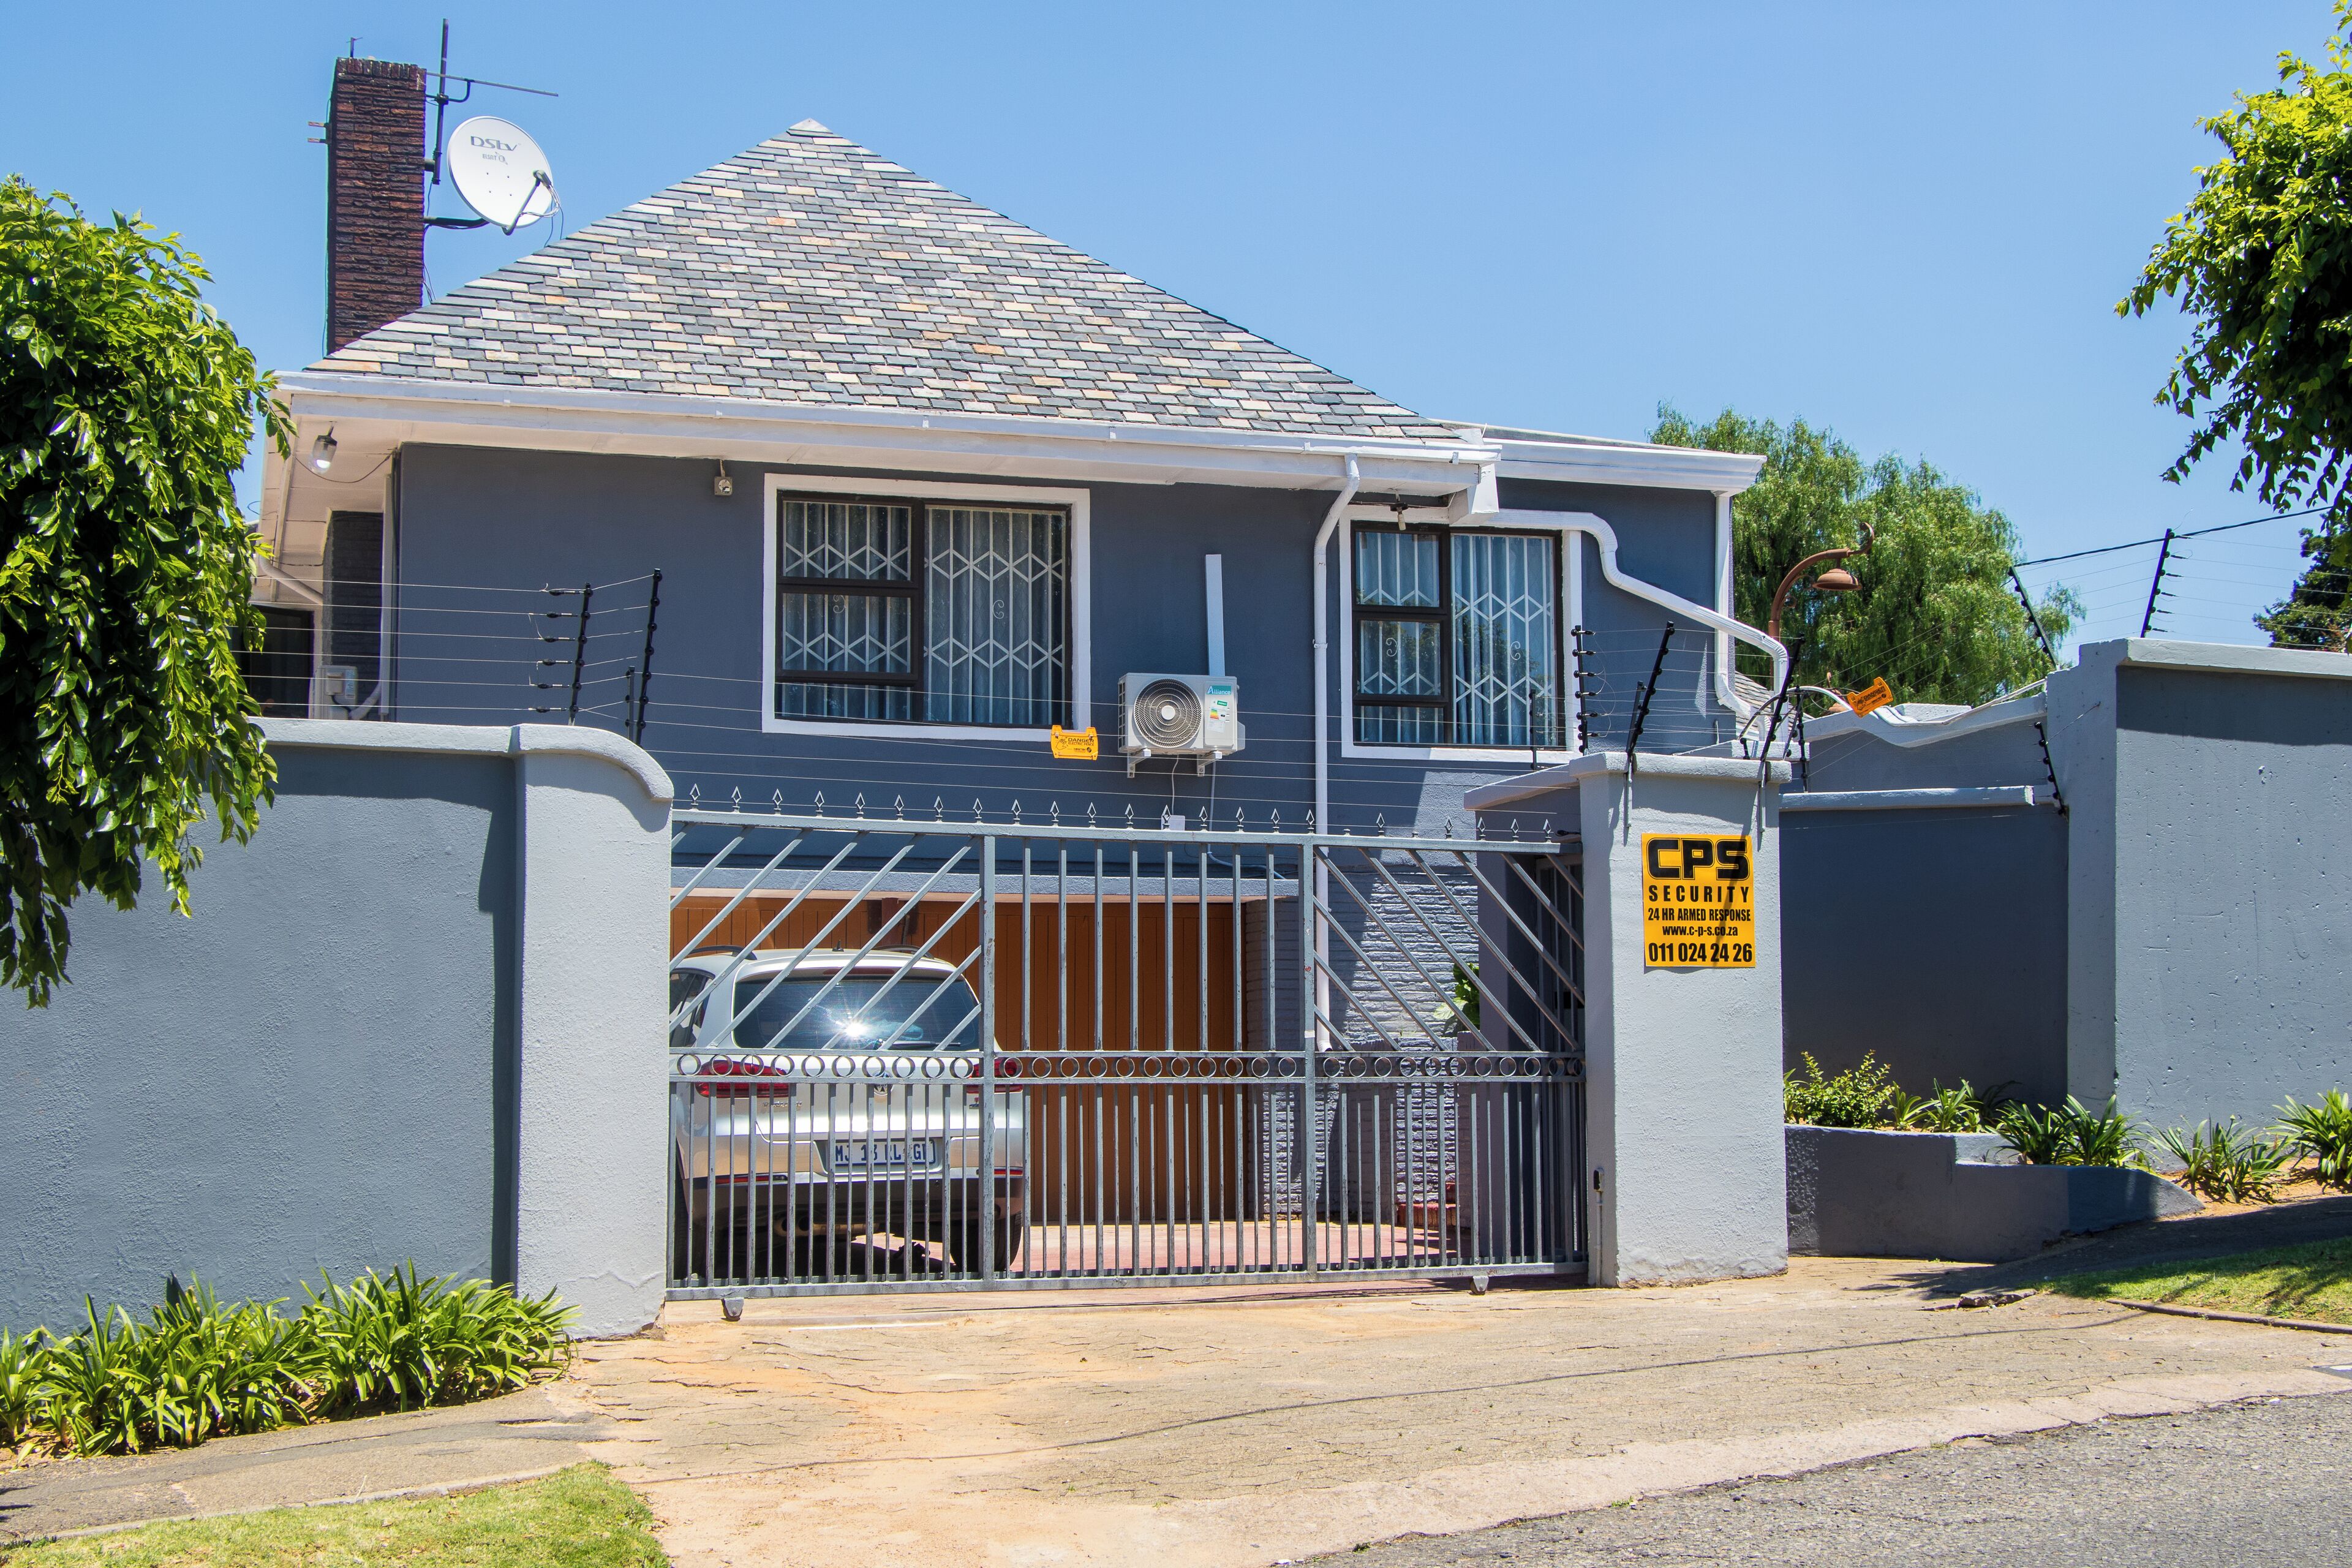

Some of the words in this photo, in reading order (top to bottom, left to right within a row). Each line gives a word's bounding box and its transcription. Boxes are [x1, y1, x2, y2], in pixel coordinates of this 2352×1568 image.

[1207, 686, 1231, 695] Alliance
[1646, 838, 1750, 881] CPS
[1649, 885, 1749, 902] SECURITY
[1648, 908, 1660, 921] 24
[1662, 908, 1675, 921] HR
[1678, 908, 1706, 921] ARMED
[1709, 909, 1751, 921] RESPONSE
[1662, 926, 1738, 937] www.c-p-s.co.za
[1648, 943, 1674, 962] 011
[1678, 943, 1707, 962] 024
[1710, 943, 1729, 962] 24
[1733, 943, 1752, 962] 26
